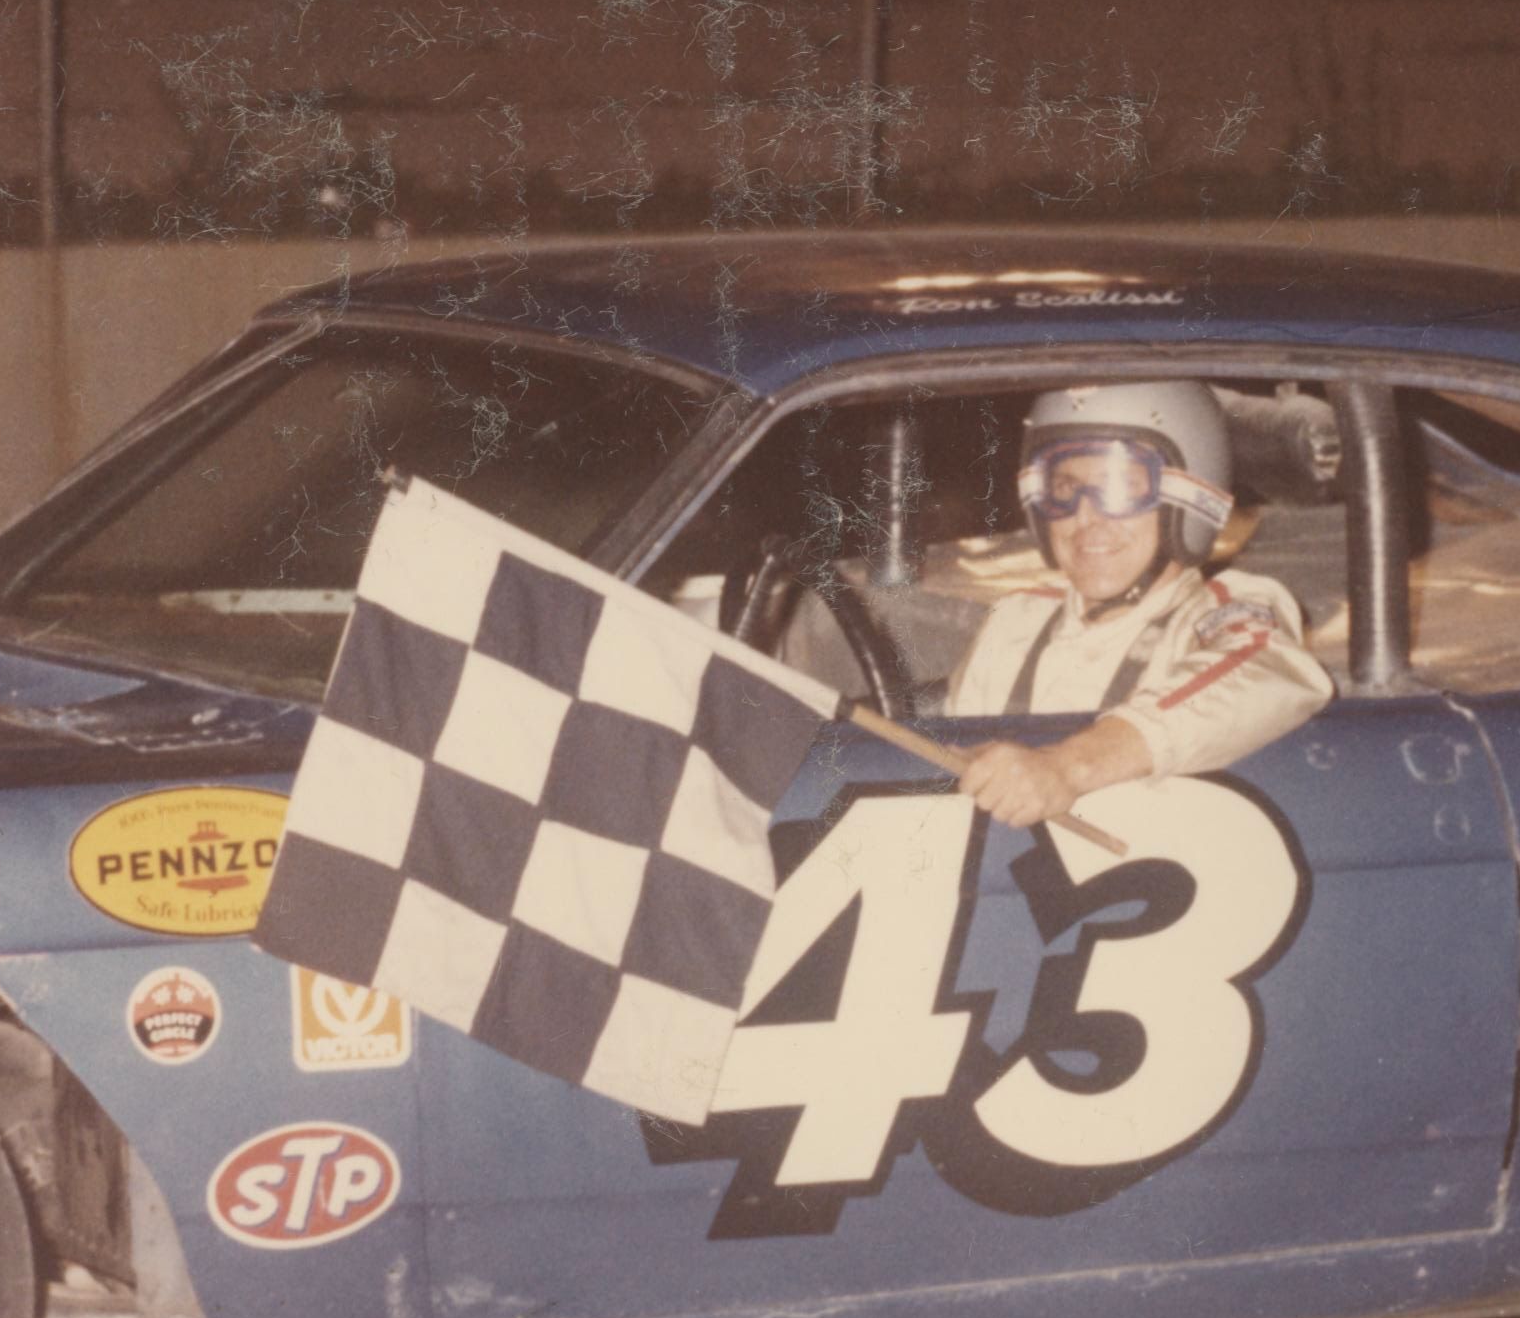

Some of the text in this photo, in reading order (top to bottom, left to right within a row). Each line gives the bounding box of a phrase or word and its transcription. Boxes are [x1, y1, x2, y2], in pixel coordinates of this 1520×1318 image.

[896, 296, 1000, 314] Ron
[97, 838, 278, 885] PENNZO
[706, 773, 1300, 1187] 43
[144, 1011, 203, 1031] PERFECT
[150, 1026, 197, 1043] CIRCLE
[304, 1034, 397, 1061] VICTOR
[229, 1134, 382, 1232] STP
